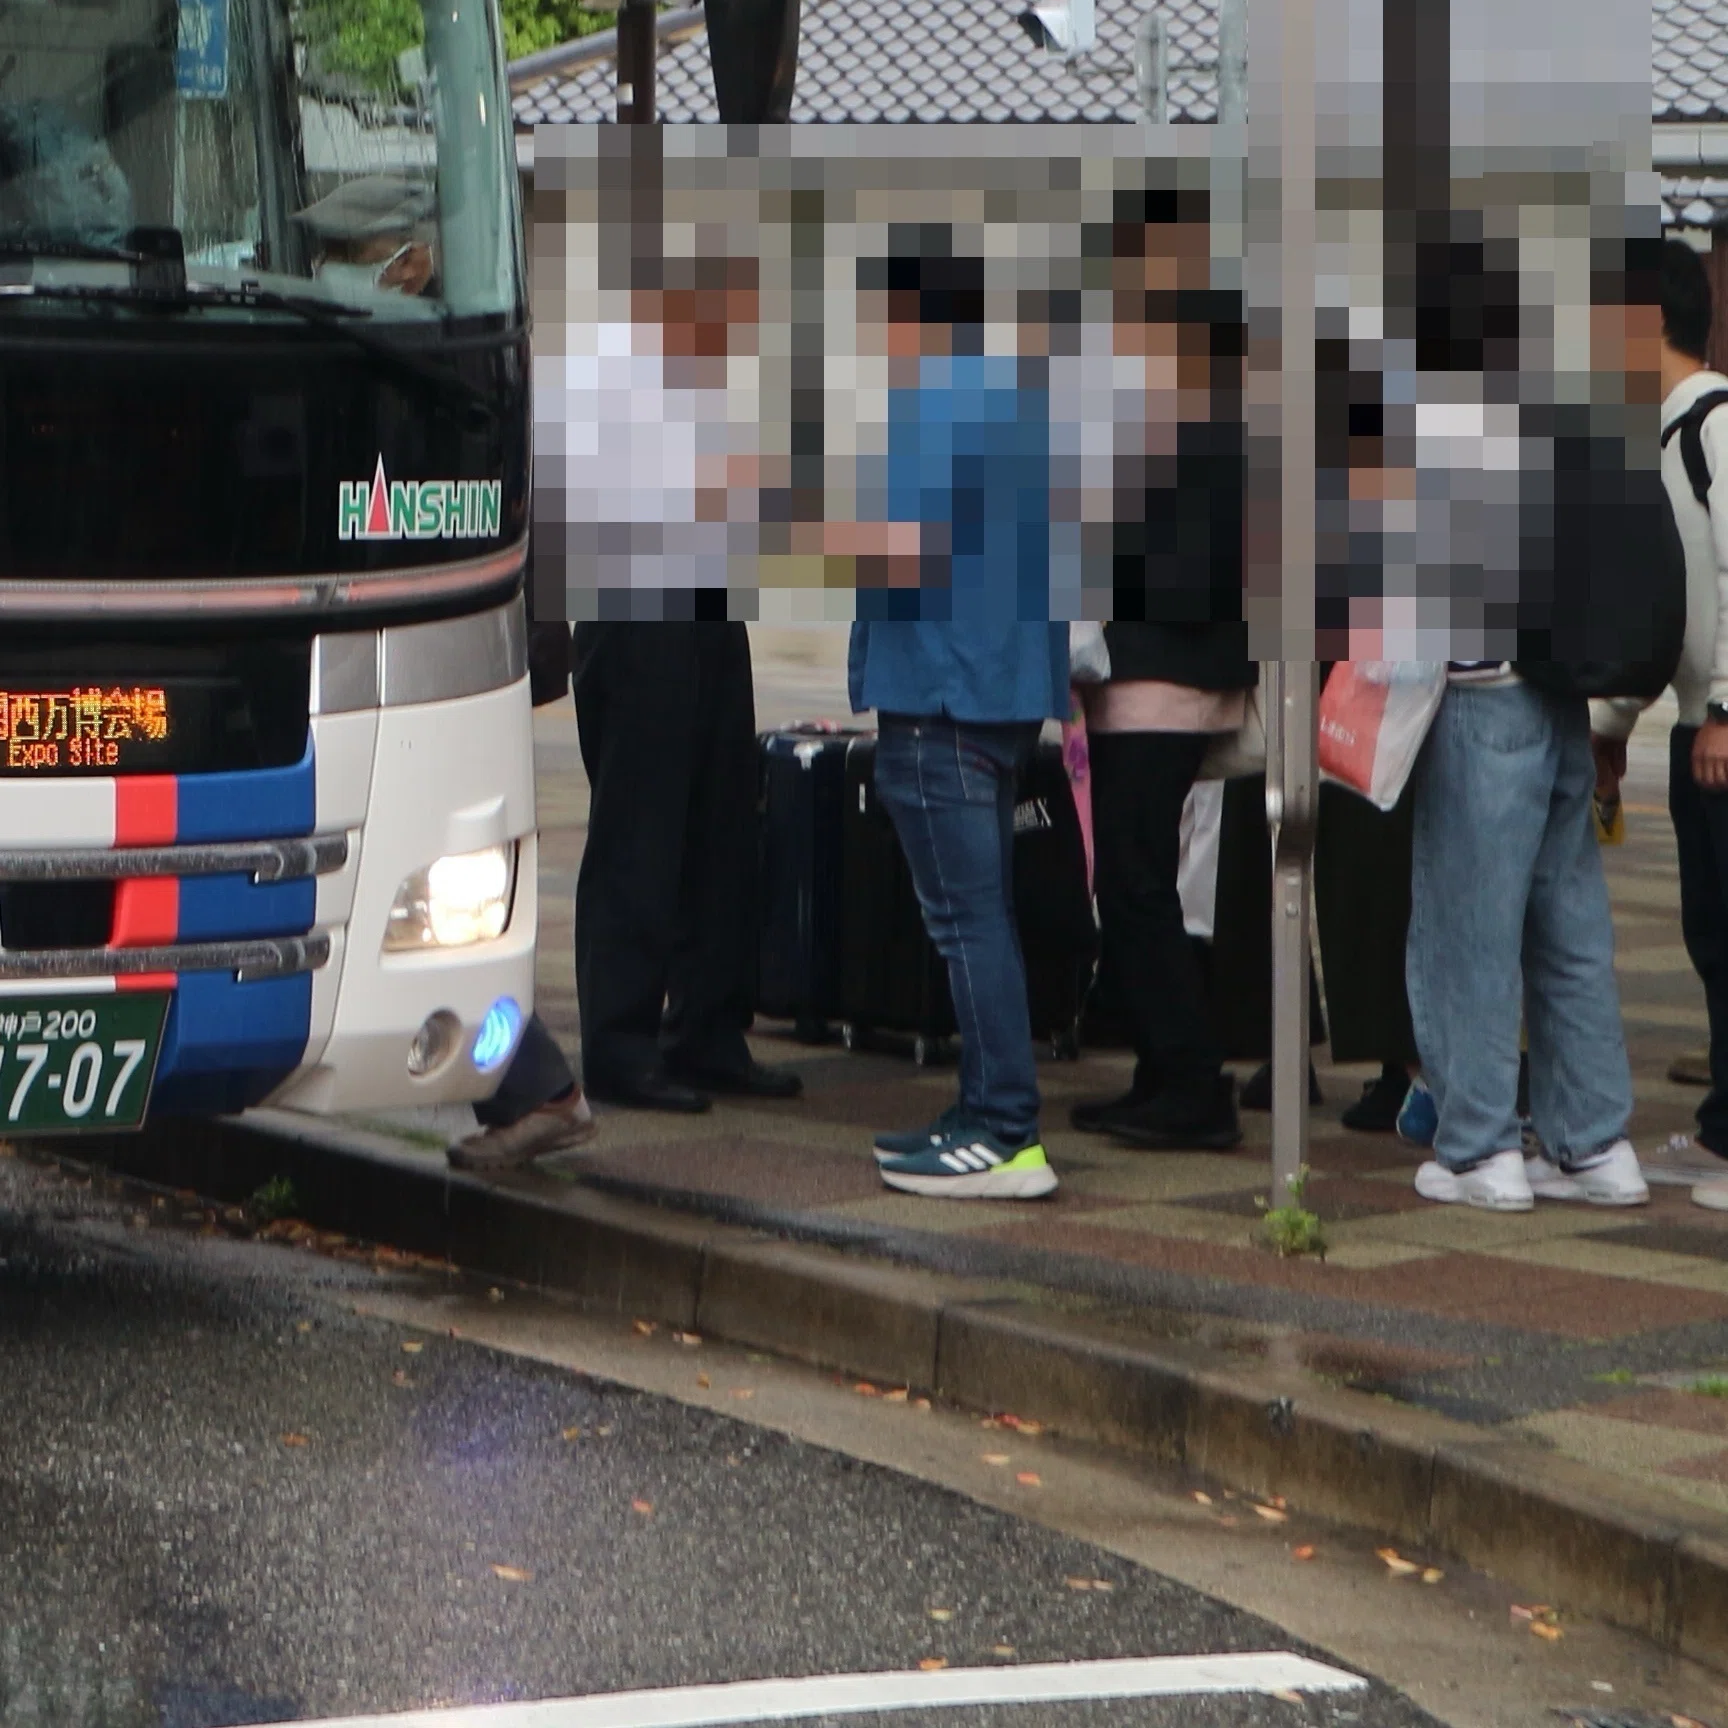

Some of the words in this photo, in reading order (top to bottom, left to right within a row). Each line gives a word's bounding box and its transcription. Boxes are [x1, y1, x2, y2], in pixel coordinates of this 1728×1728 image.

[339, 452, 502, 541] HANSHIN
[8, 738, 59, 769] Expo
[69, 737, 120, 767] Site
